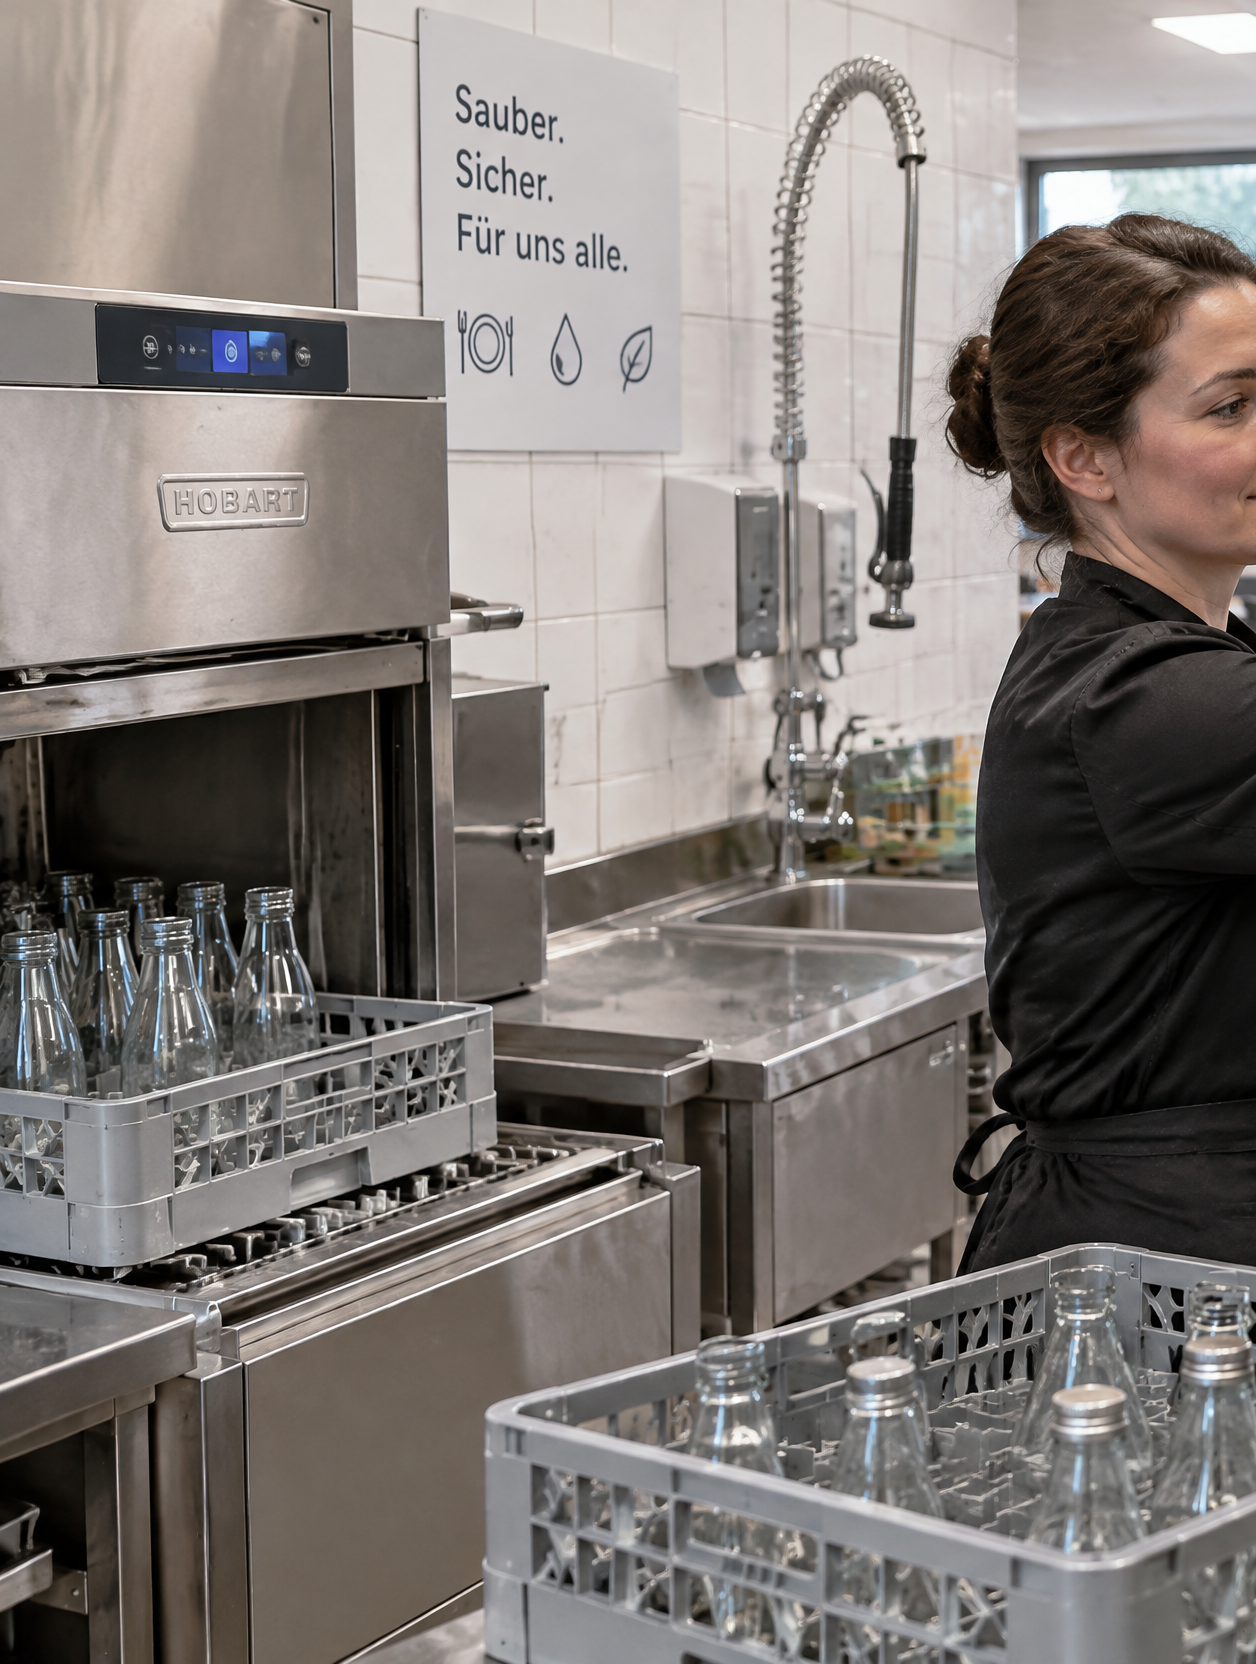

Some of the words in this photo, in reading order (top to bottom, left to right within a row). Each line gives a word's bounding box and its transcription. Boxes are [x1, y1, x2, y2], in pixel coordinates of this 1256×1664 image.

[455, 84, 564, 144] Sauber.
[456, 149, 553, 203] Sicher.
[457, 212, 505, 256] Für
[516, 232, 565, 265] uns
[575, 232, 628, 273] alle.
[174, 487, 298, 515] HOBART
